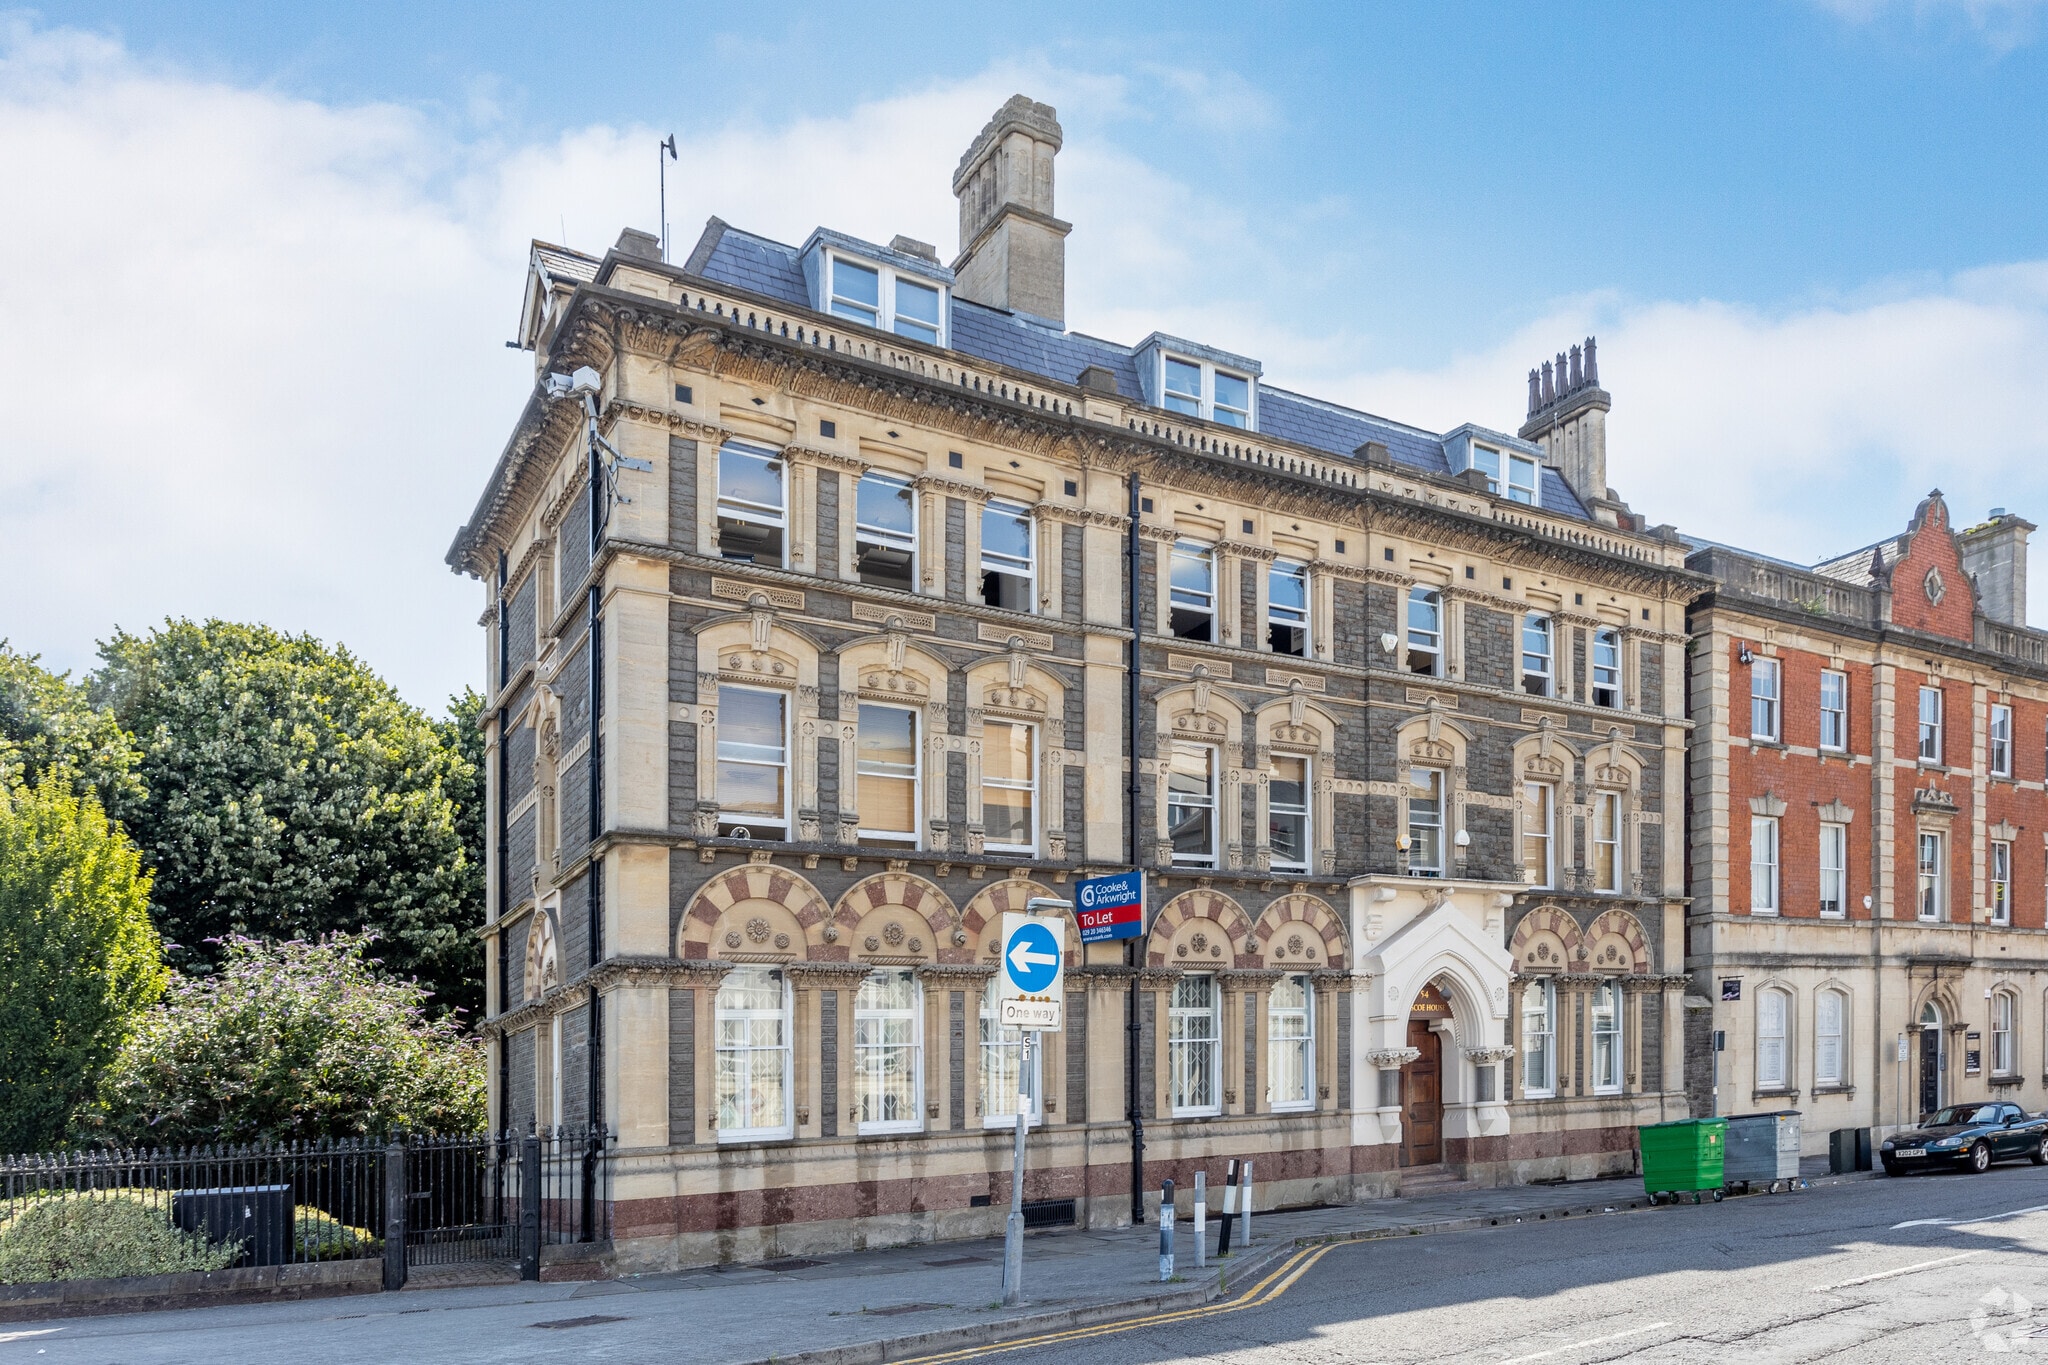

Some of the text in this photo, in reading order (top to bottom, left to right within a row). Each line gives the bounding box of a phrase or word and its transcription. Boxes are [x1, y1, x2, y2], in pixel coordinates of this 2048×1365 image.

[1095, 881, 1128, 894] Cooke&
[1096, 891, 1136, 905] Arkwright
[1081, 912, 1113, 926] To Let
[1420, 990, 1429, 998] 54
[1006, 1006, 1055, 1021] One way
[1426, 1003, 1445, 1011] HOUSE
